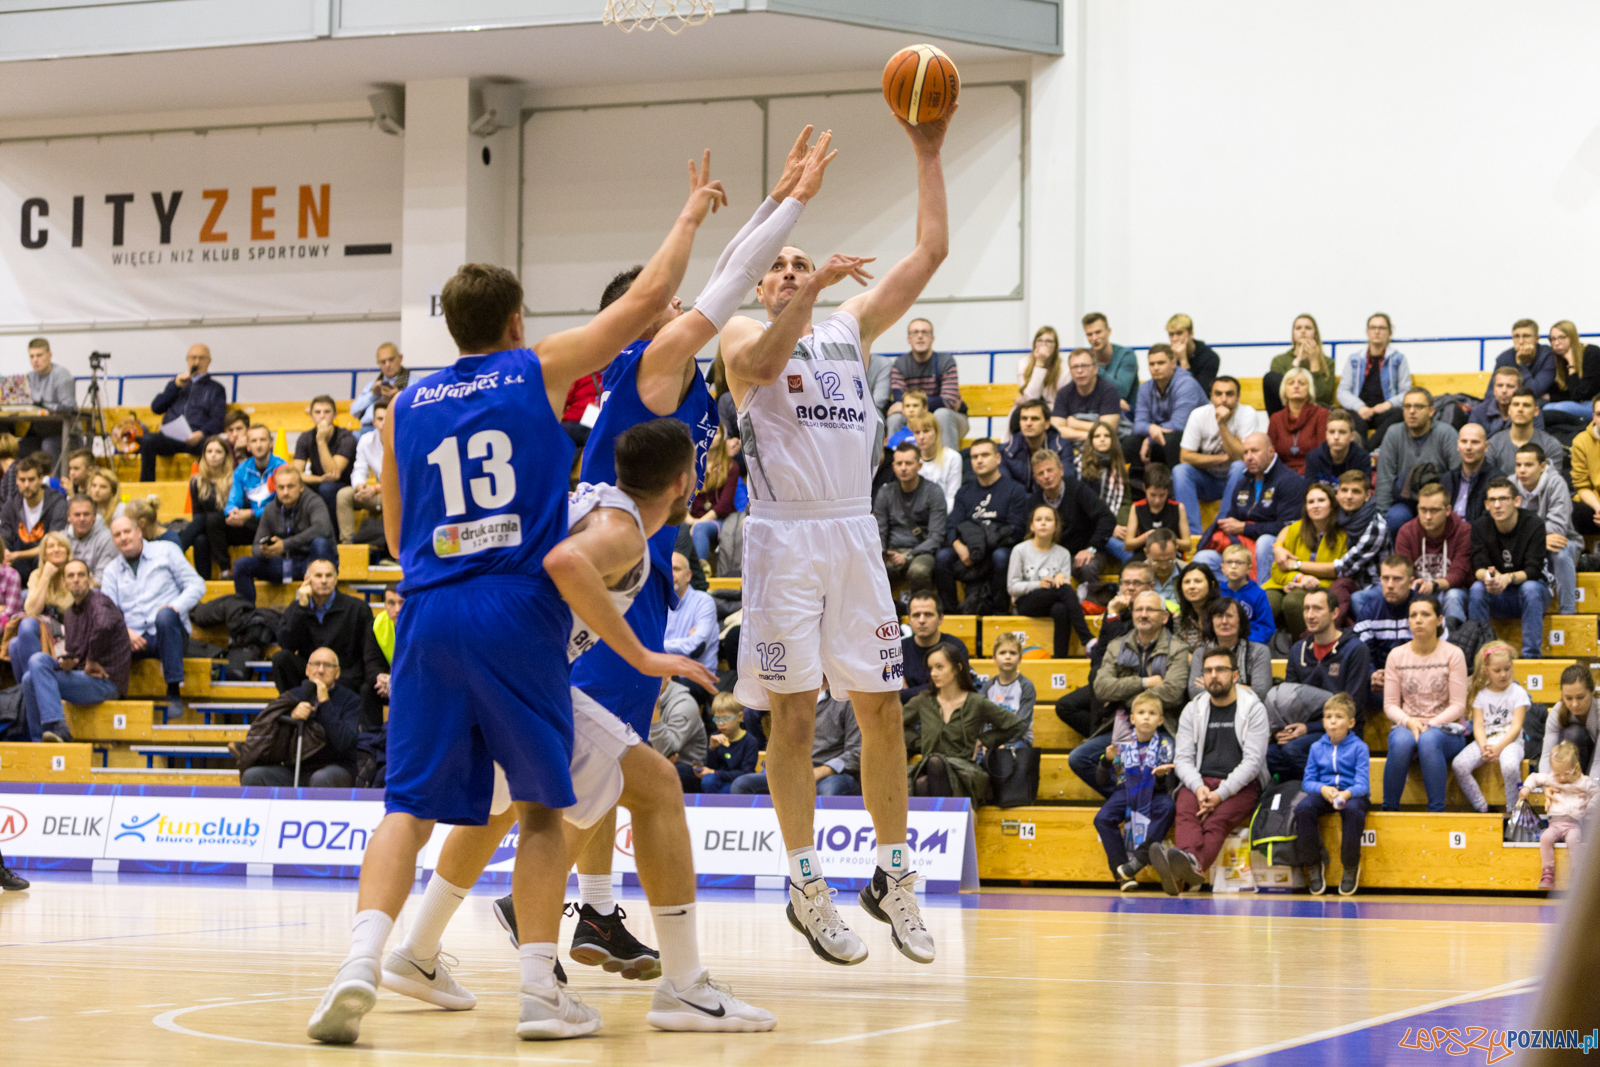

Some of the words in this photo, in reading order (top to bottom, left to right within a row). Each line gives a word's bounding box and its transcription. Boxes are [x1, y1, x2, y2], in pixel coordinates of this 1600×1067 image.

[20, 183, 331, 249] CITYZEN
[112, 251, 163, 268] WIĘCEJ
[170, 248, 195, 264] NIŻ
[202, 246, 240, 262] KLUB
[248, 244, 331, 261] SPORTOWY
[814, 370, 845, 401] 12
[426, 429, 517, 517] 13
[460, 519, 519, 541] drukarnia
[1553, 632, 1561, 643] 9
[756, 642, 787, 672] 12
[1053, 676, 1065, 686] 15
[1531, 677, 1539, 688] 9
[42, 815, 103, 837] DELIK
[157, 815, 260, 837] funclub
[278, 820, 376, 850] POZn
[1021, 825, 1034, 837] 14
[156, 835, 193, 843] biuro
[704, 830, 776, 852] DELIK
[1454, 834, 1462, 846] 9
